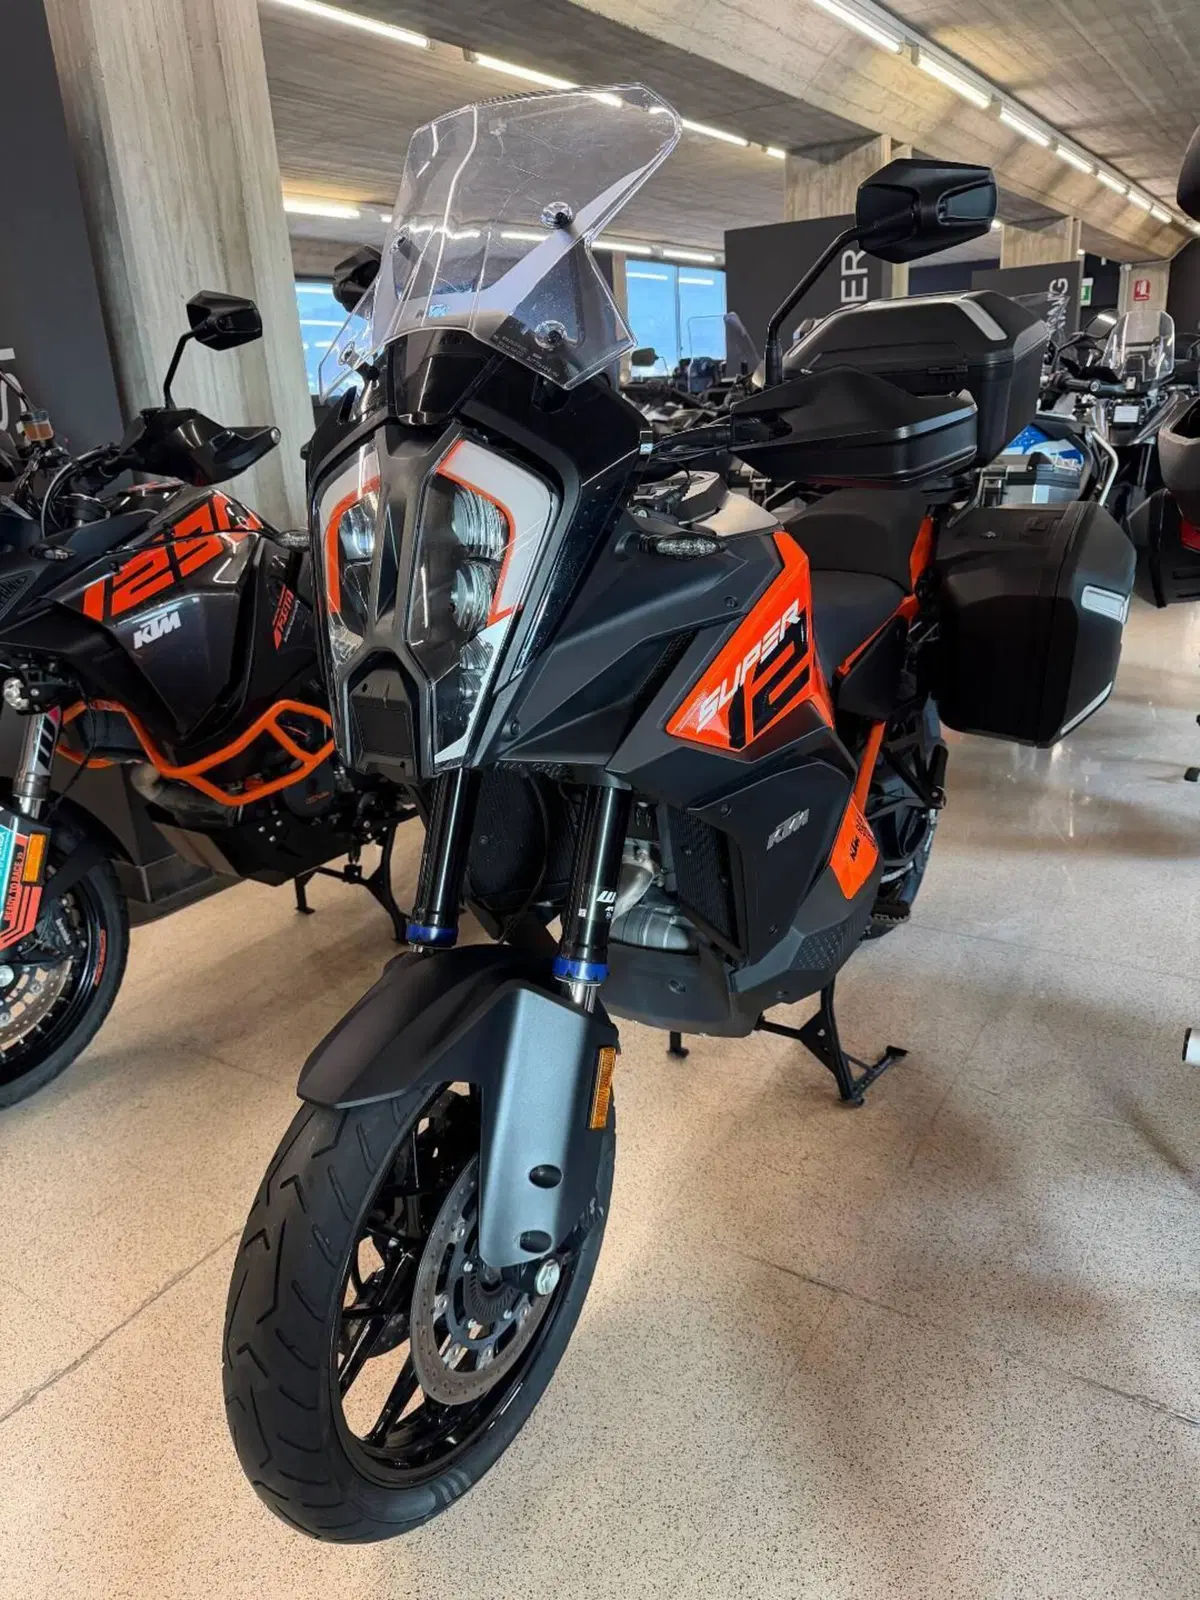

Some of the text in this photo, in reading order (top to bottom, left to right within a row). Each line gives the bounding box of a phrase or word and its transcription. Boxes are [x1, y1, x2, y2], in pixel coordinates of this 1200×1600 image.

[132, 610, 182, 650] KTM
[696, 598, 801, 734] SUPER
[766, 808, 810, 852] KTM
